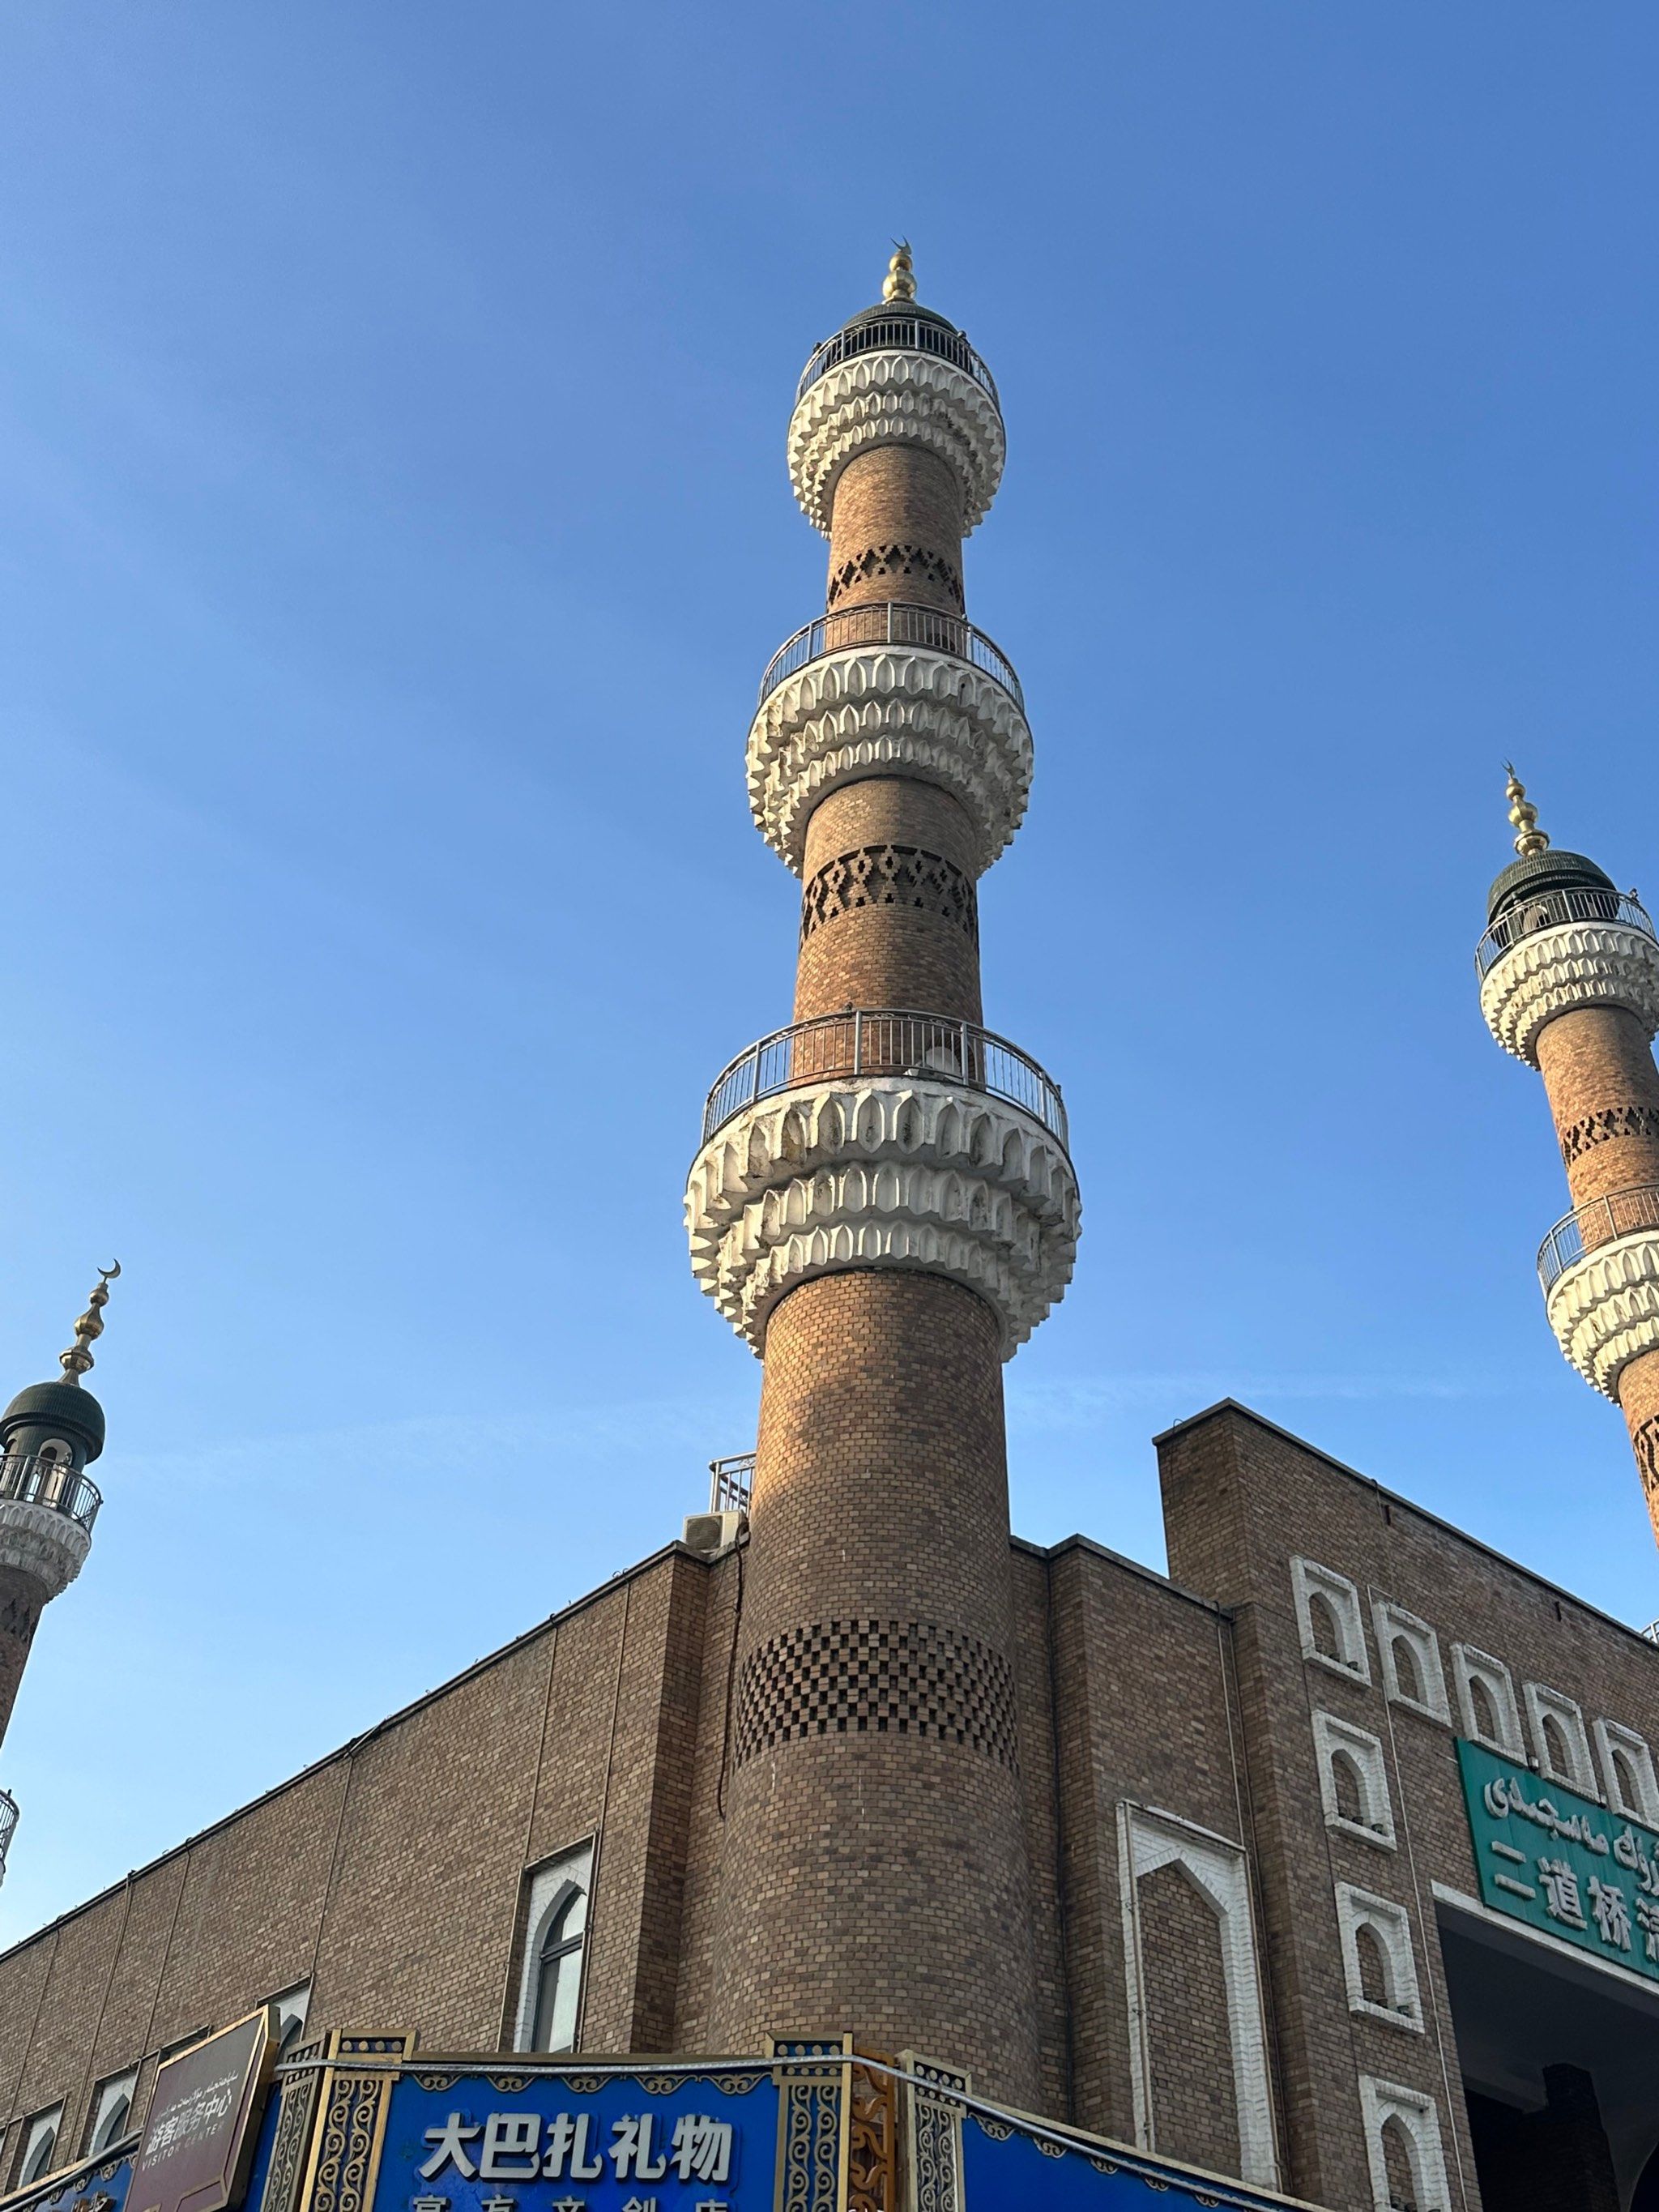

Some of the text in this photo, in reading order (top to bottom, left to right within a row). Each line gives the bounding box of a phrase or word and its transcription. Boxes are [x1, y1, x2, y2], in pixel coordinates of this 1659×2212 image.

[142, 2120, 224, 2171] VISITOR CENTER
[146, 2088, 232, 2155] 游客服务中心
[418, 2112, 734, 2182] 大巴扎礼物
